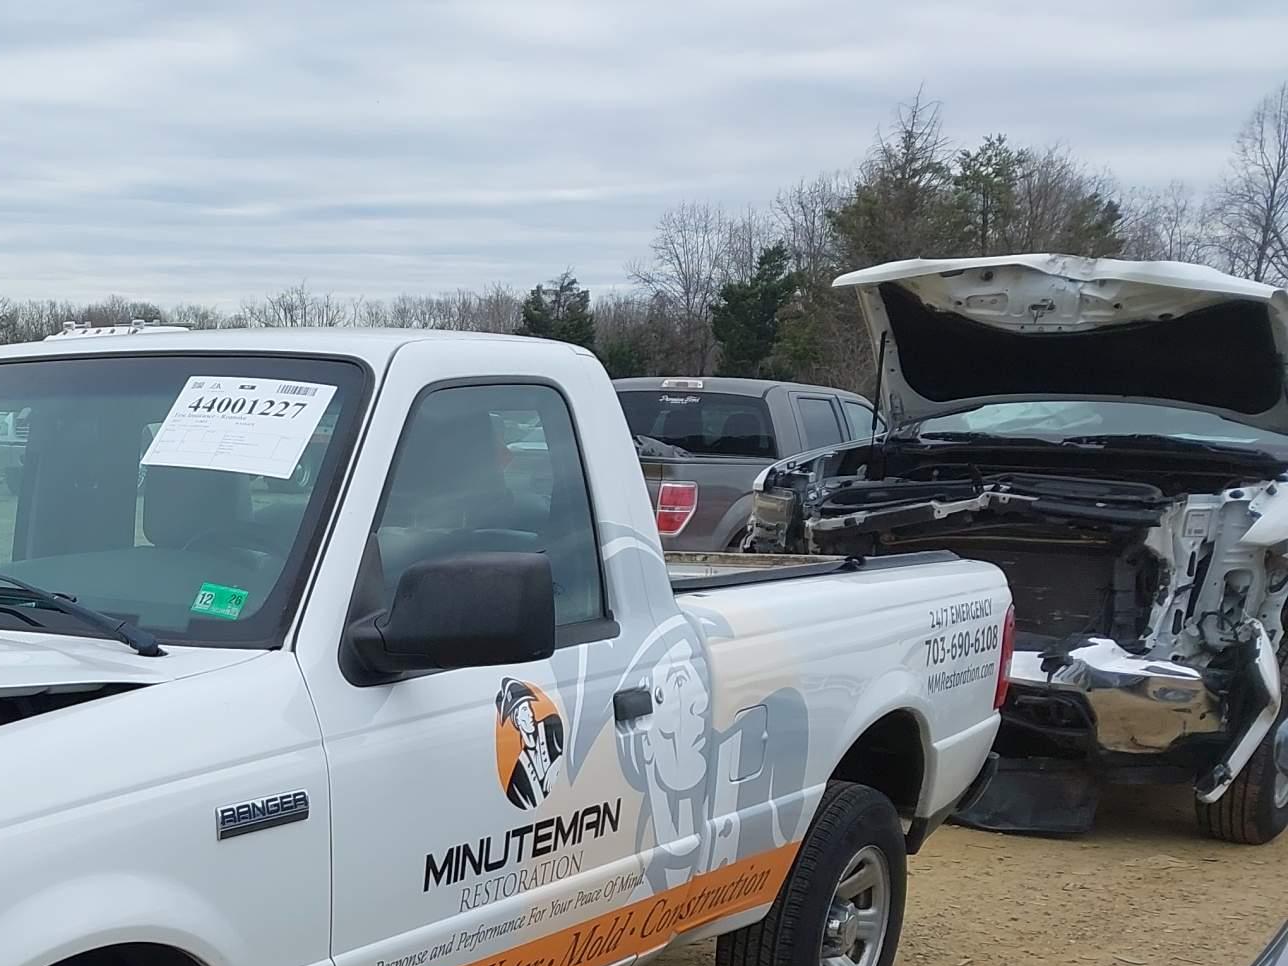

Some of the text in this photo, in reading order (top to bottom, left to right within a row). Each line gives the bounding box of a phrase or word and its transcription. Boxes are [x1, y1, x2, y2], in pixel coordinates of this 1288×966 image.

[188, 396, 307, 419] 44001227
[199, 592, 243, 606] 12 26
[929, 598, 992, 629] 24/7 EMERGENCY
[925, 624, 999, 667] 703-690-6108
[927, 662, 995, 695] MMRestoration.com
[220, 791, 310, 825] RANGER
[423, 798, 622, 893] MINUTEMAN
[459, 851, 585, 913] RESTORATION
[429, 934, 454, 962] and
[455, 912, 526, 953] Performance
[528, 905, 548, 927] For
[549, 897, 573, 918] Your
[573, 887, 602, 909] Peace
[603, 876, 620, 902] Of
[640, 864, 771, 939] Construction
